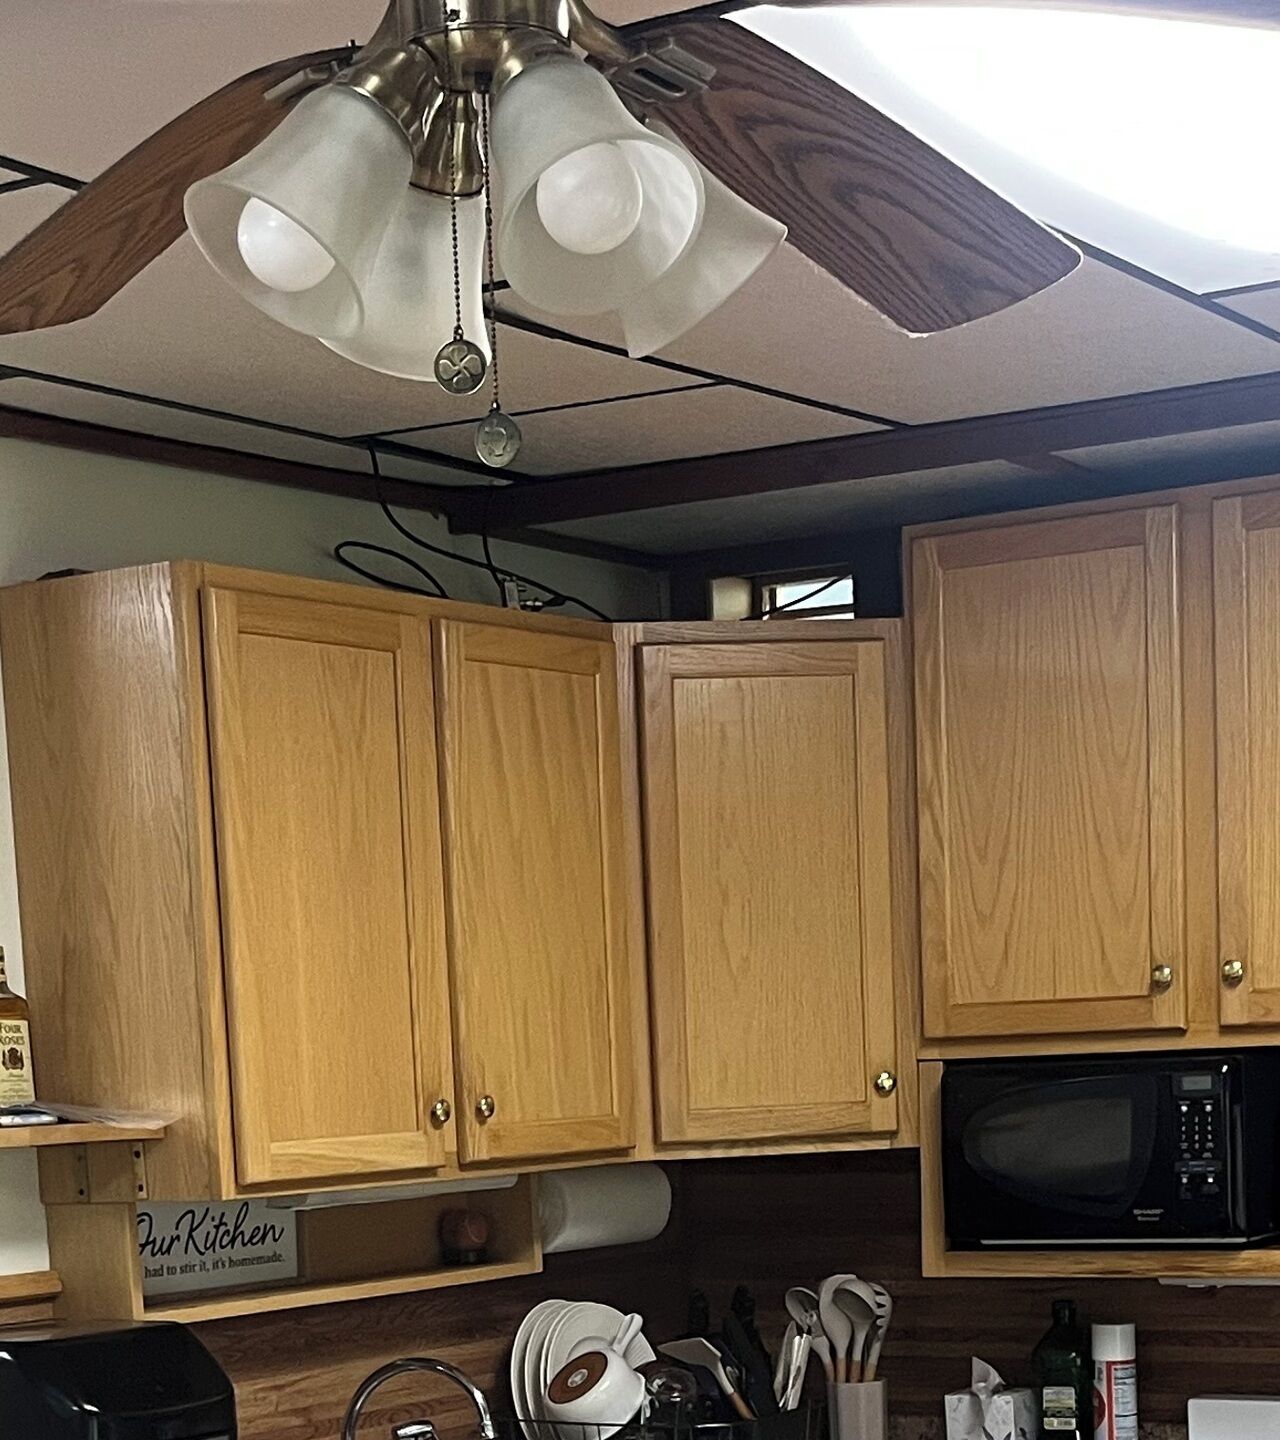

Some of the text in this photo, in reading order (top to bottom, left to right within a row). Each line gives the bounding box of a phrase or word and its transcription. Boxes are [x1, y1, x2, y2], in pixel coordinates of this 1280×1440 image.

[175, 1201, 285, 1256] Kitchen
[144, 1250, 285, 1279] had to stir it, it's homemade.
